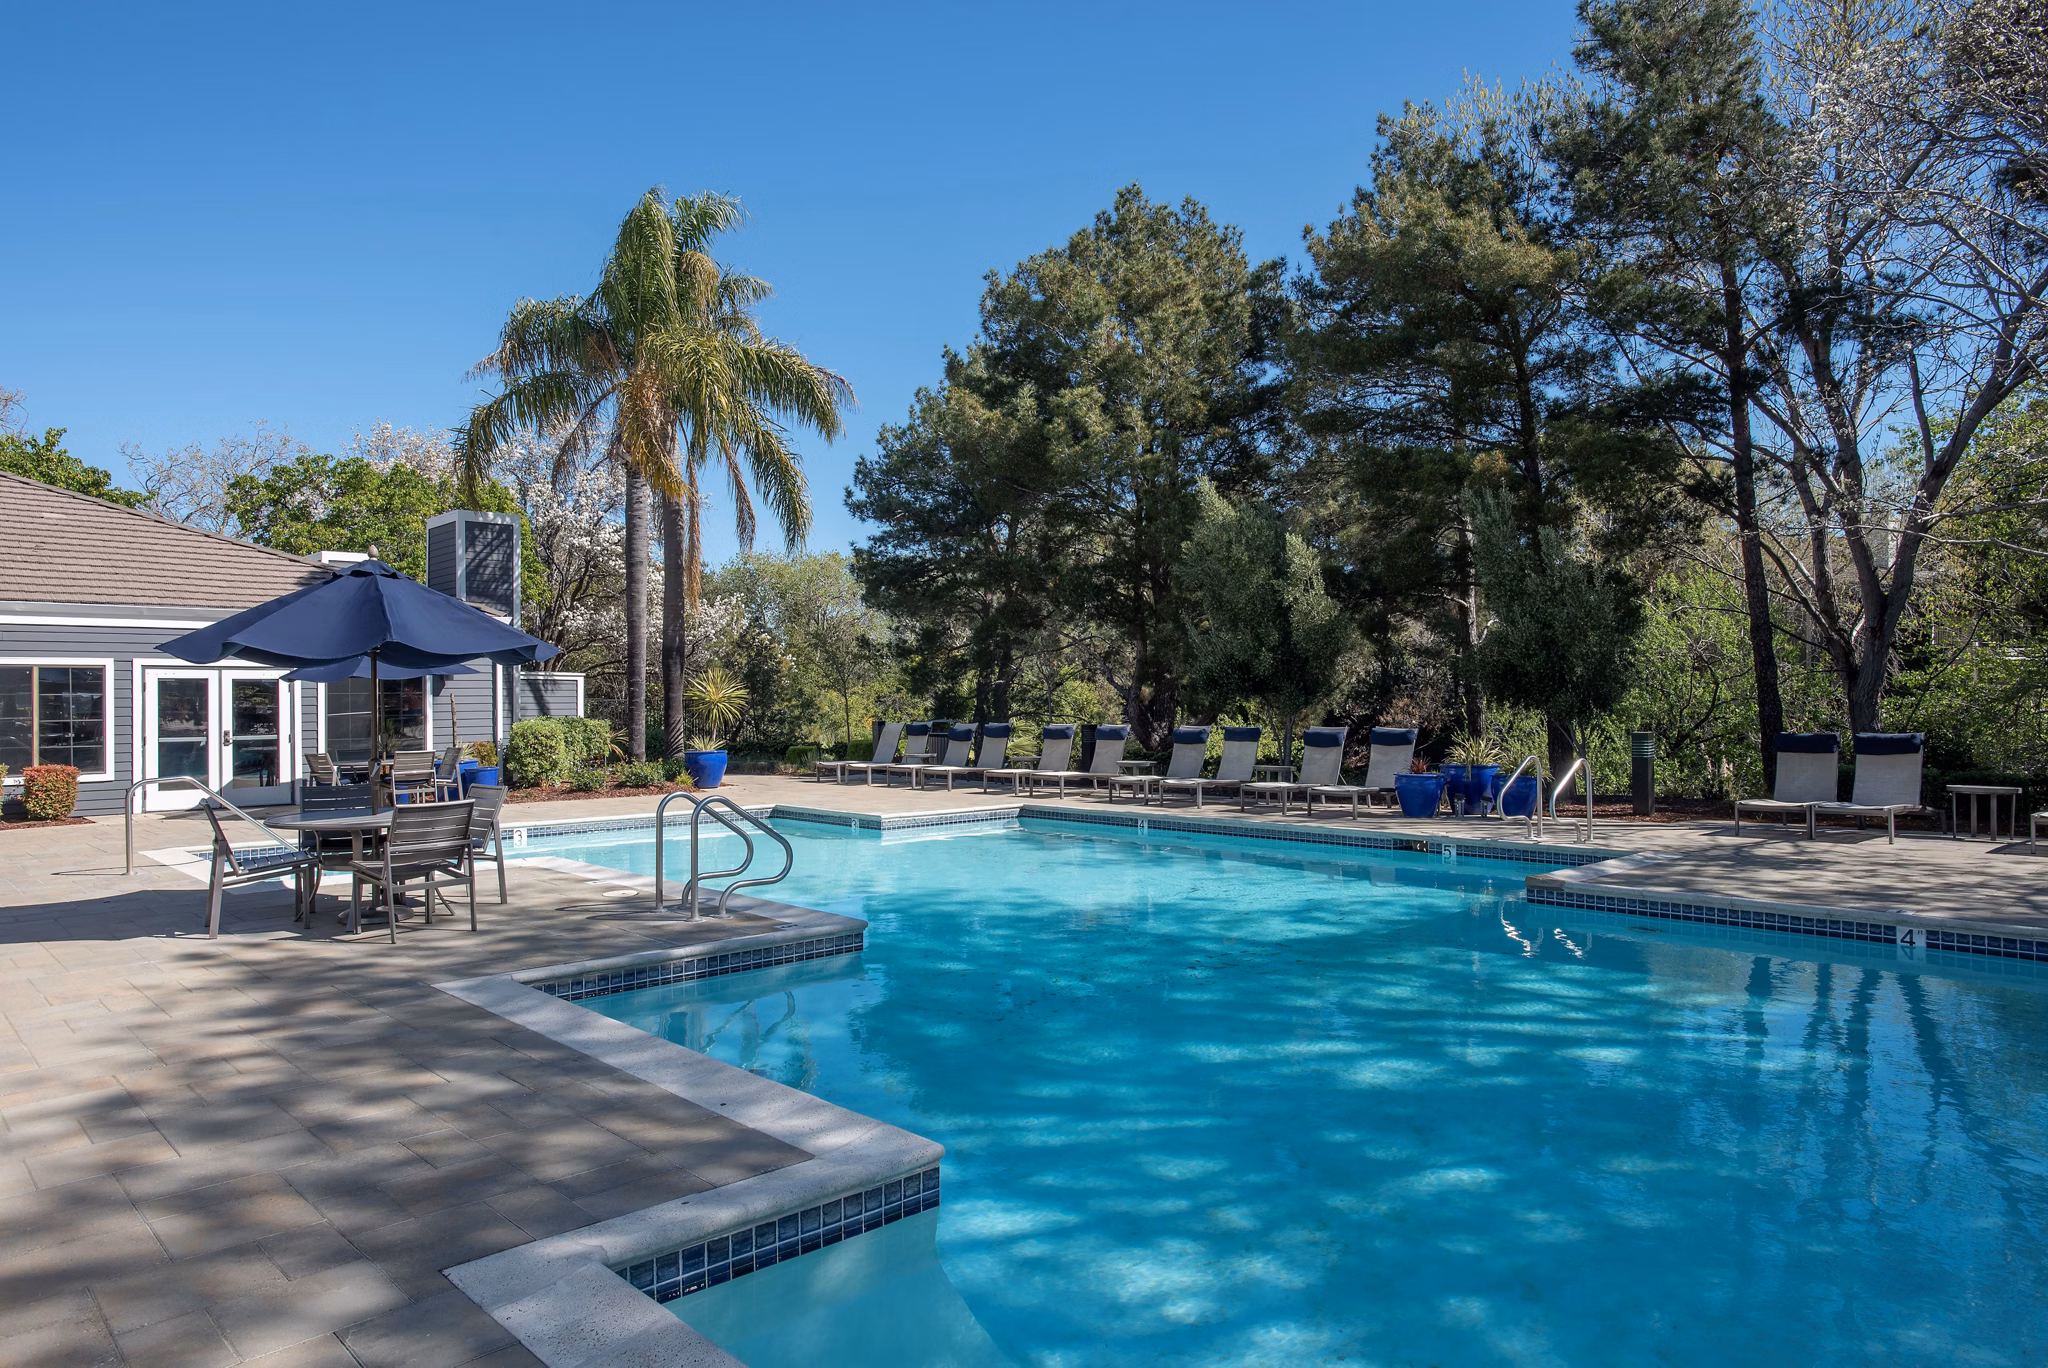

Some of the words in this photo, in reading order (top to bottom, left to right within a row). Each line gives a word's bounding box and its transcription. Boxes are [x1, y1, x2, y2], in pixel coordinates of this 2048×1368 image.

[1139, 819, 1144, 828] 4
[514, 829, 523, 840] 3
[1443, 845, 1451, 855] 5
[1900, 929, 1916, 946] 4
